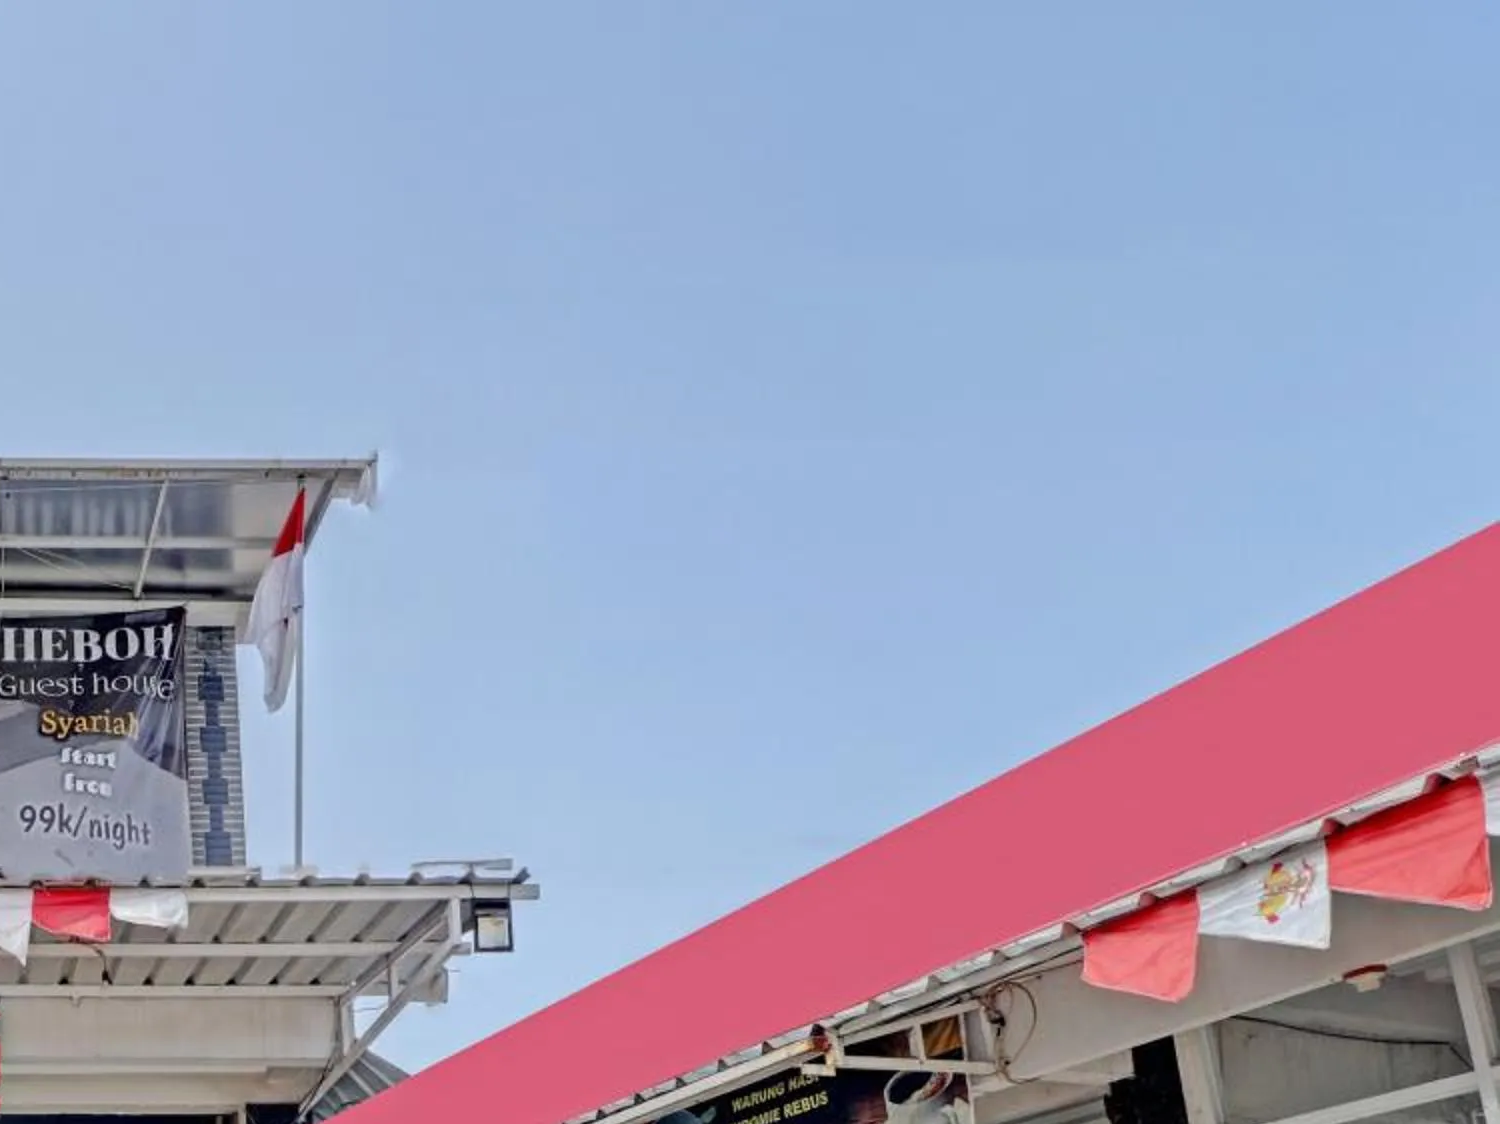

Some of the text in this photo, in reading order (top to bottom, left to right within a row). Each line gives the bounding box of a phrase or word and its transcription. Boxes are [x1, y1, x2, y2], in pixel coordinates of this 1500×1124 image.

[2, 624, 174, 663] HEBOH
[92, 672, 174, 699] house
[19, 802, 152, 850] 99k/night
[731, 1081, 786, 1114] WARUNG
[783, 1090, 829, 1118] REBUS
